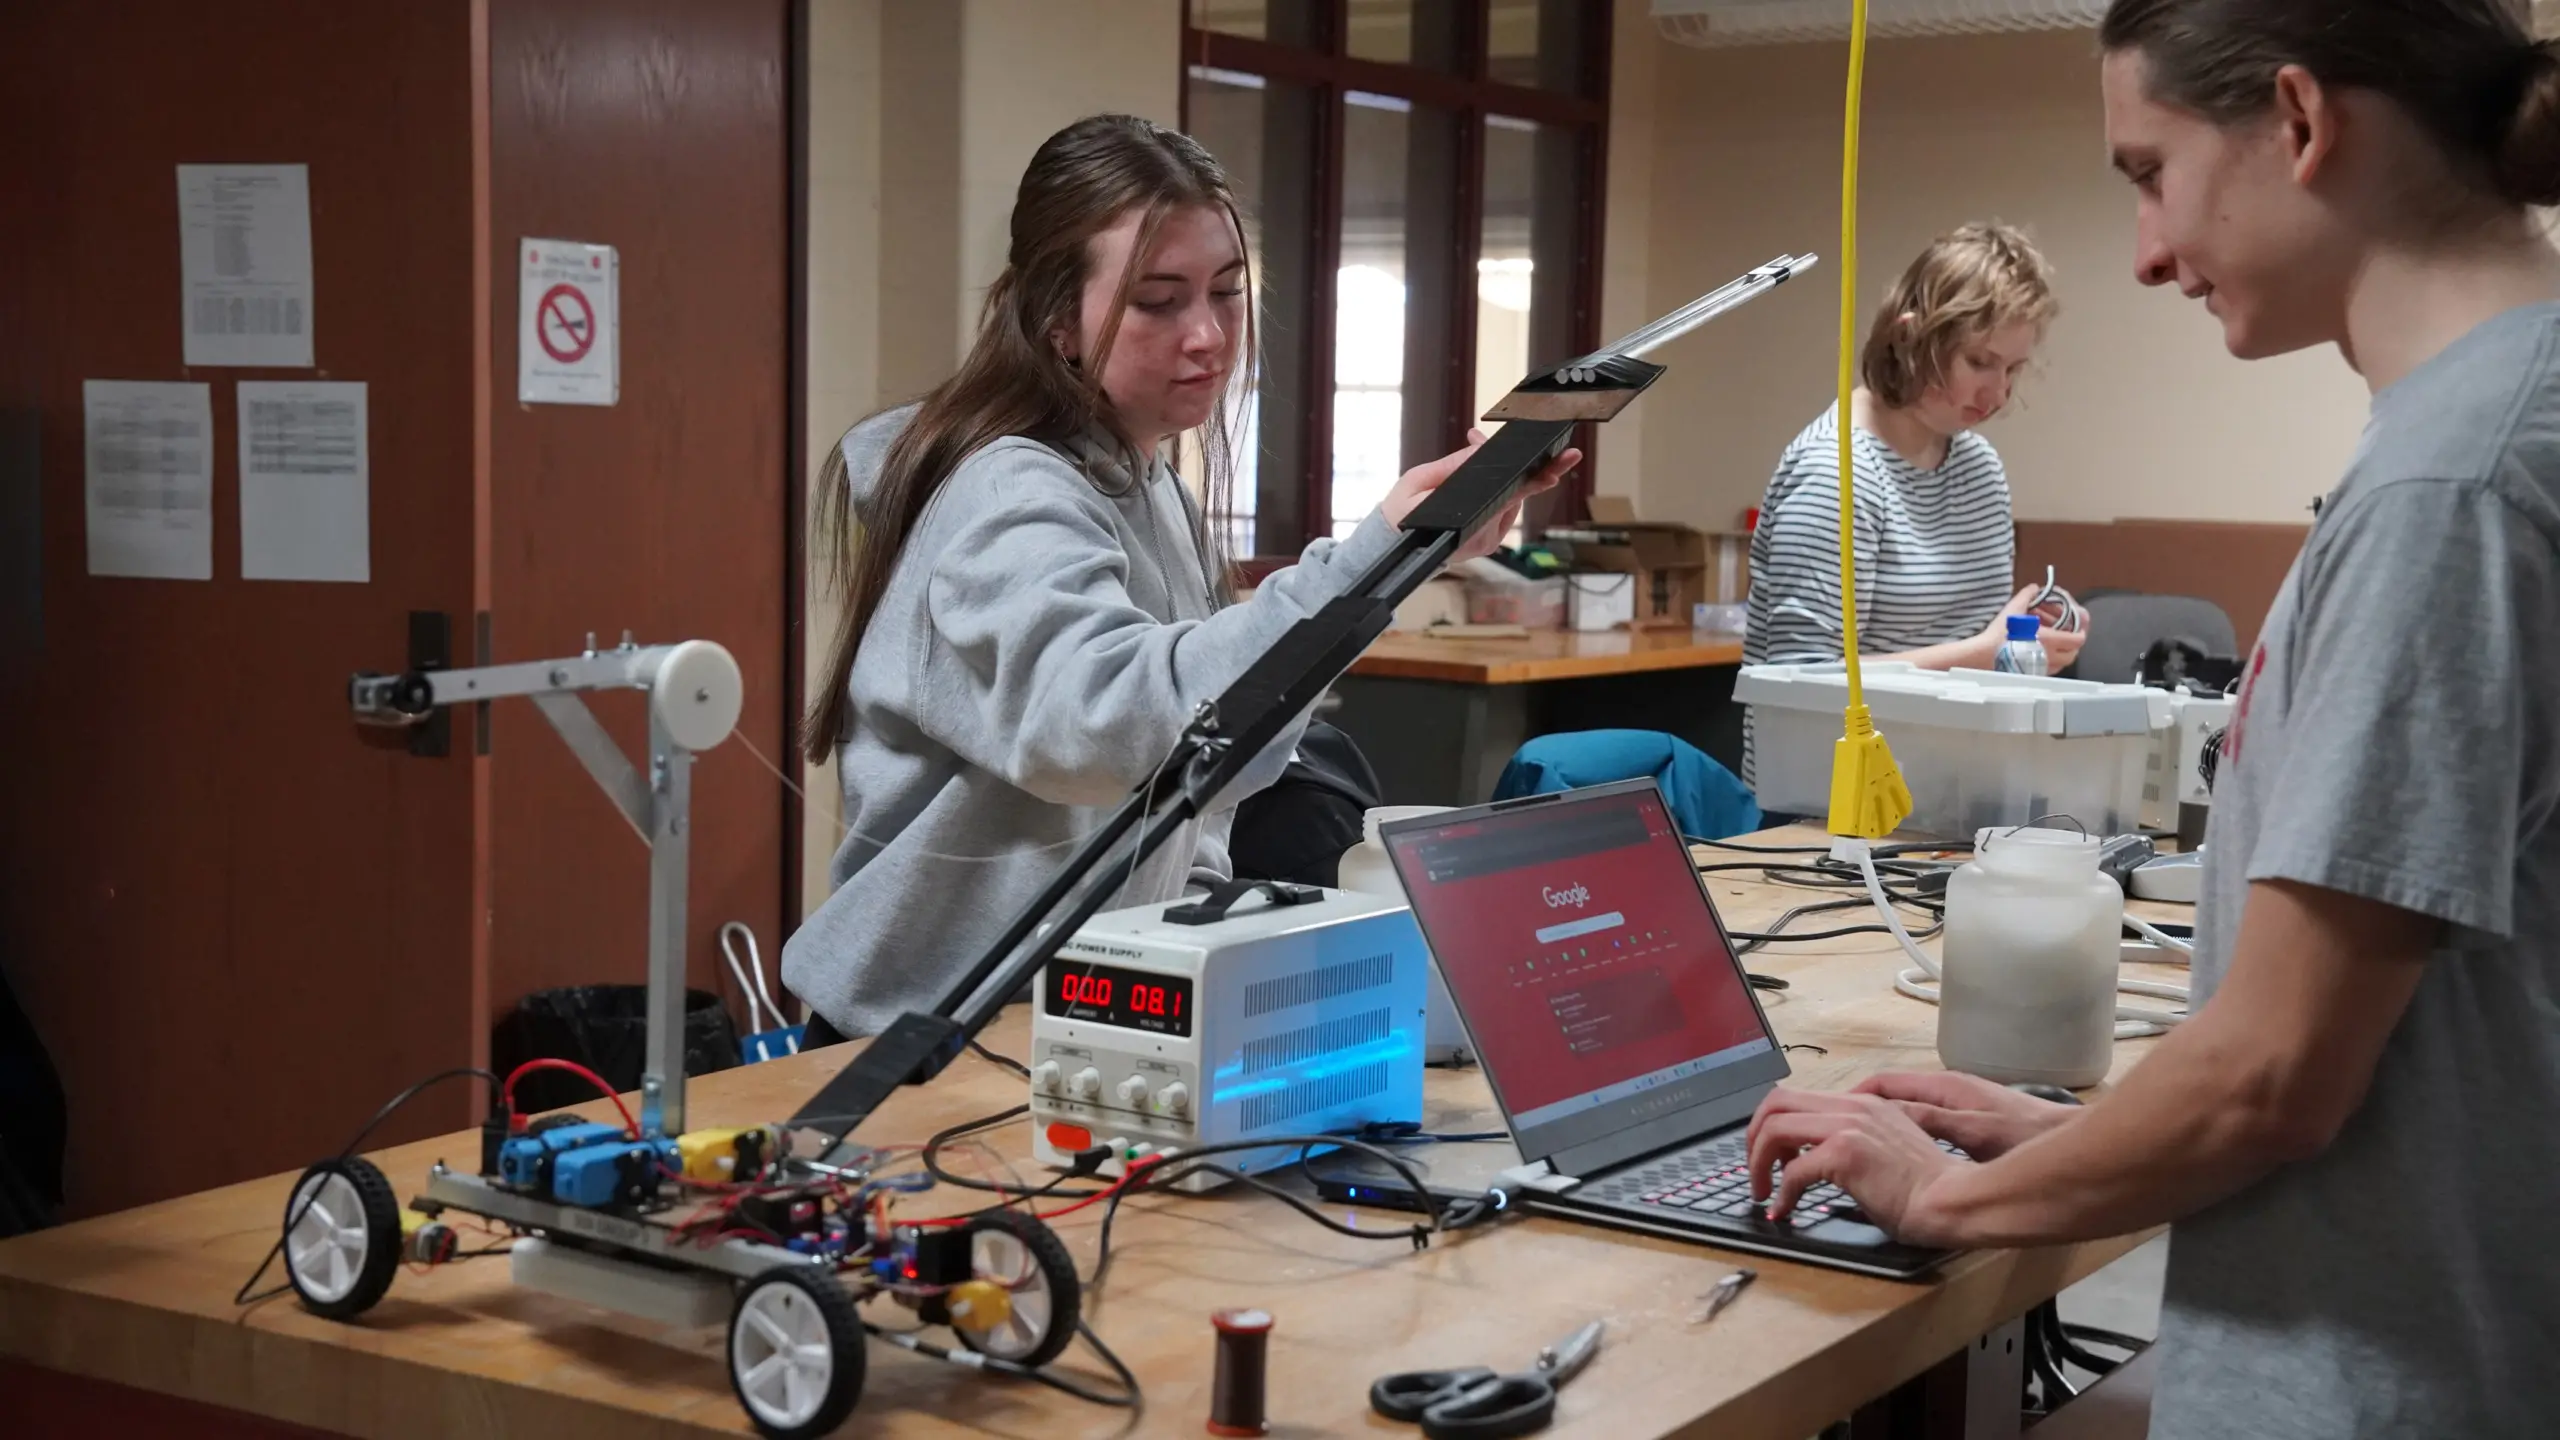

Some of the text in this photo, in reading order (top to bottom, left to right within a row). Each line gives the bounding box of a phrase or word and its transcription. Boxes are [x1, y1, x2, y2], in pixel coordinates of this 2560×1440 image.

[1542, 881, 1590, 908] Google
[1076, 942, 1107, 955] POWER
[1109, 946, 1143, 959] SUPPLY
